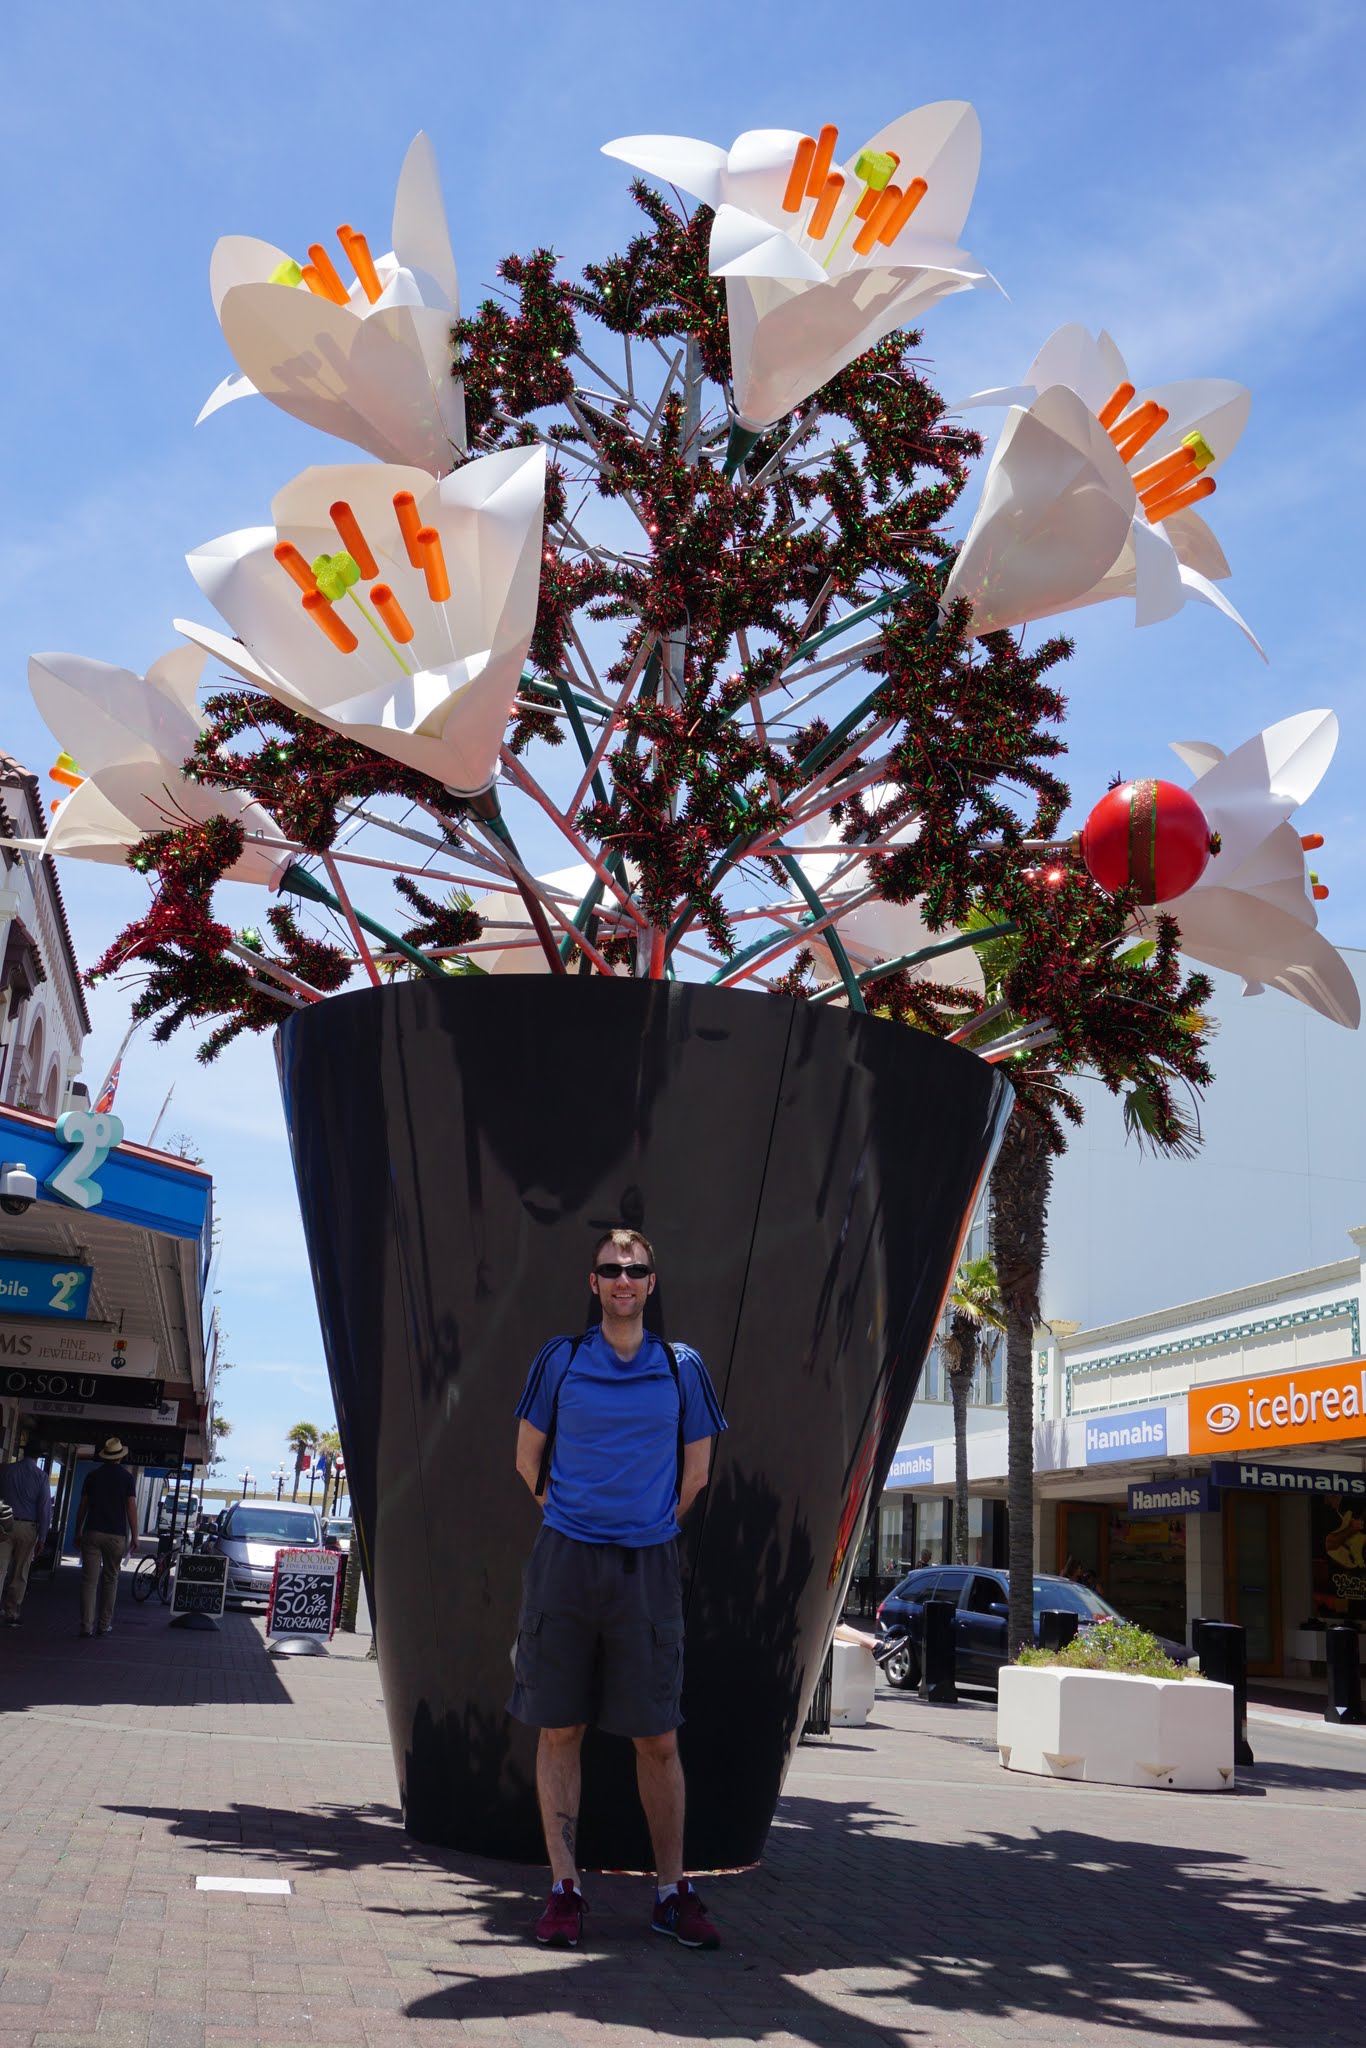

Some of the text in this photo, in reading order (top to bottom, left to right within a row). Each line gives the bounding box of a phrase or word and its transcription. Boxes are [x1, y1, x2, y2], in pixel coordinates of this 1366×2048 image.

[59, 1338, 86, 1350] FINE
[38, 1347, 104, 1362] JEWELLERY
[1248, 1370, 1366, 1430] icebrea
[1087, 1420, 1164, 1451] Hannahs
[1240, 1466, 1366, 1494] Hannahs
[1132, 1486, 1200, 1510] Hannahs
[287, 1553, 336, 1565] BLOOMS
[278, 1574, 320, 1593] 25%
[304, 1605, 328, 1616] OFF
[274, 1616, 330, 1631] STOREWIDE
